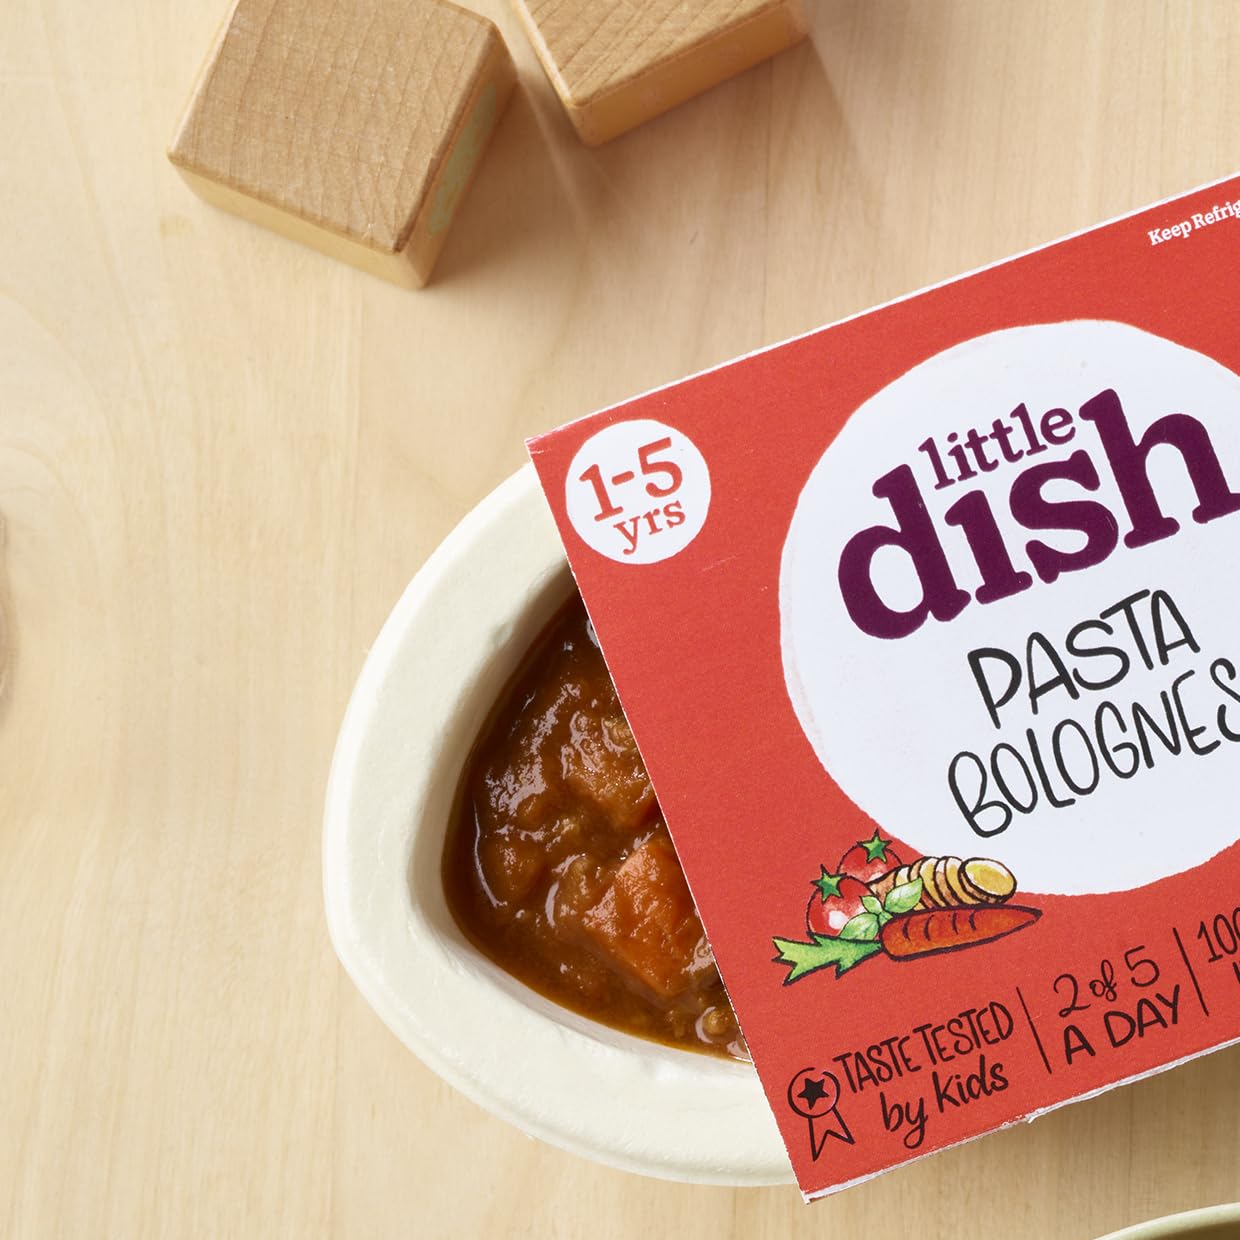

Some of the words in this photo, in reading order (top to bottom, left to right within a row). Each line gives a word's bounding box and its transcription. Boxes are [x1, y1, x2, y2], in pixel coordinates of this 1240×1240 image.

[1148, 221, 1192, 246] Keep
[579, 437, 683, 521] 1-5
[918, 402, 1076, 490] little
[613, 500, 686, 555] yrs
[967, 589, 1201, 729] PASTA
[1053, 974, 1091, 1017] 2
[1089, 960, 1117, 1001] of
[1125, 945, 1159, 987] 5
[833, 1036, 921, 1093] TASTE
[913, 1001, 1014, 1065] TESTED
[1063, 1024, 1096, 1064] A
[1104, 984, 1180, 1048] DAY
[880, 1092, 928, 1149] by
